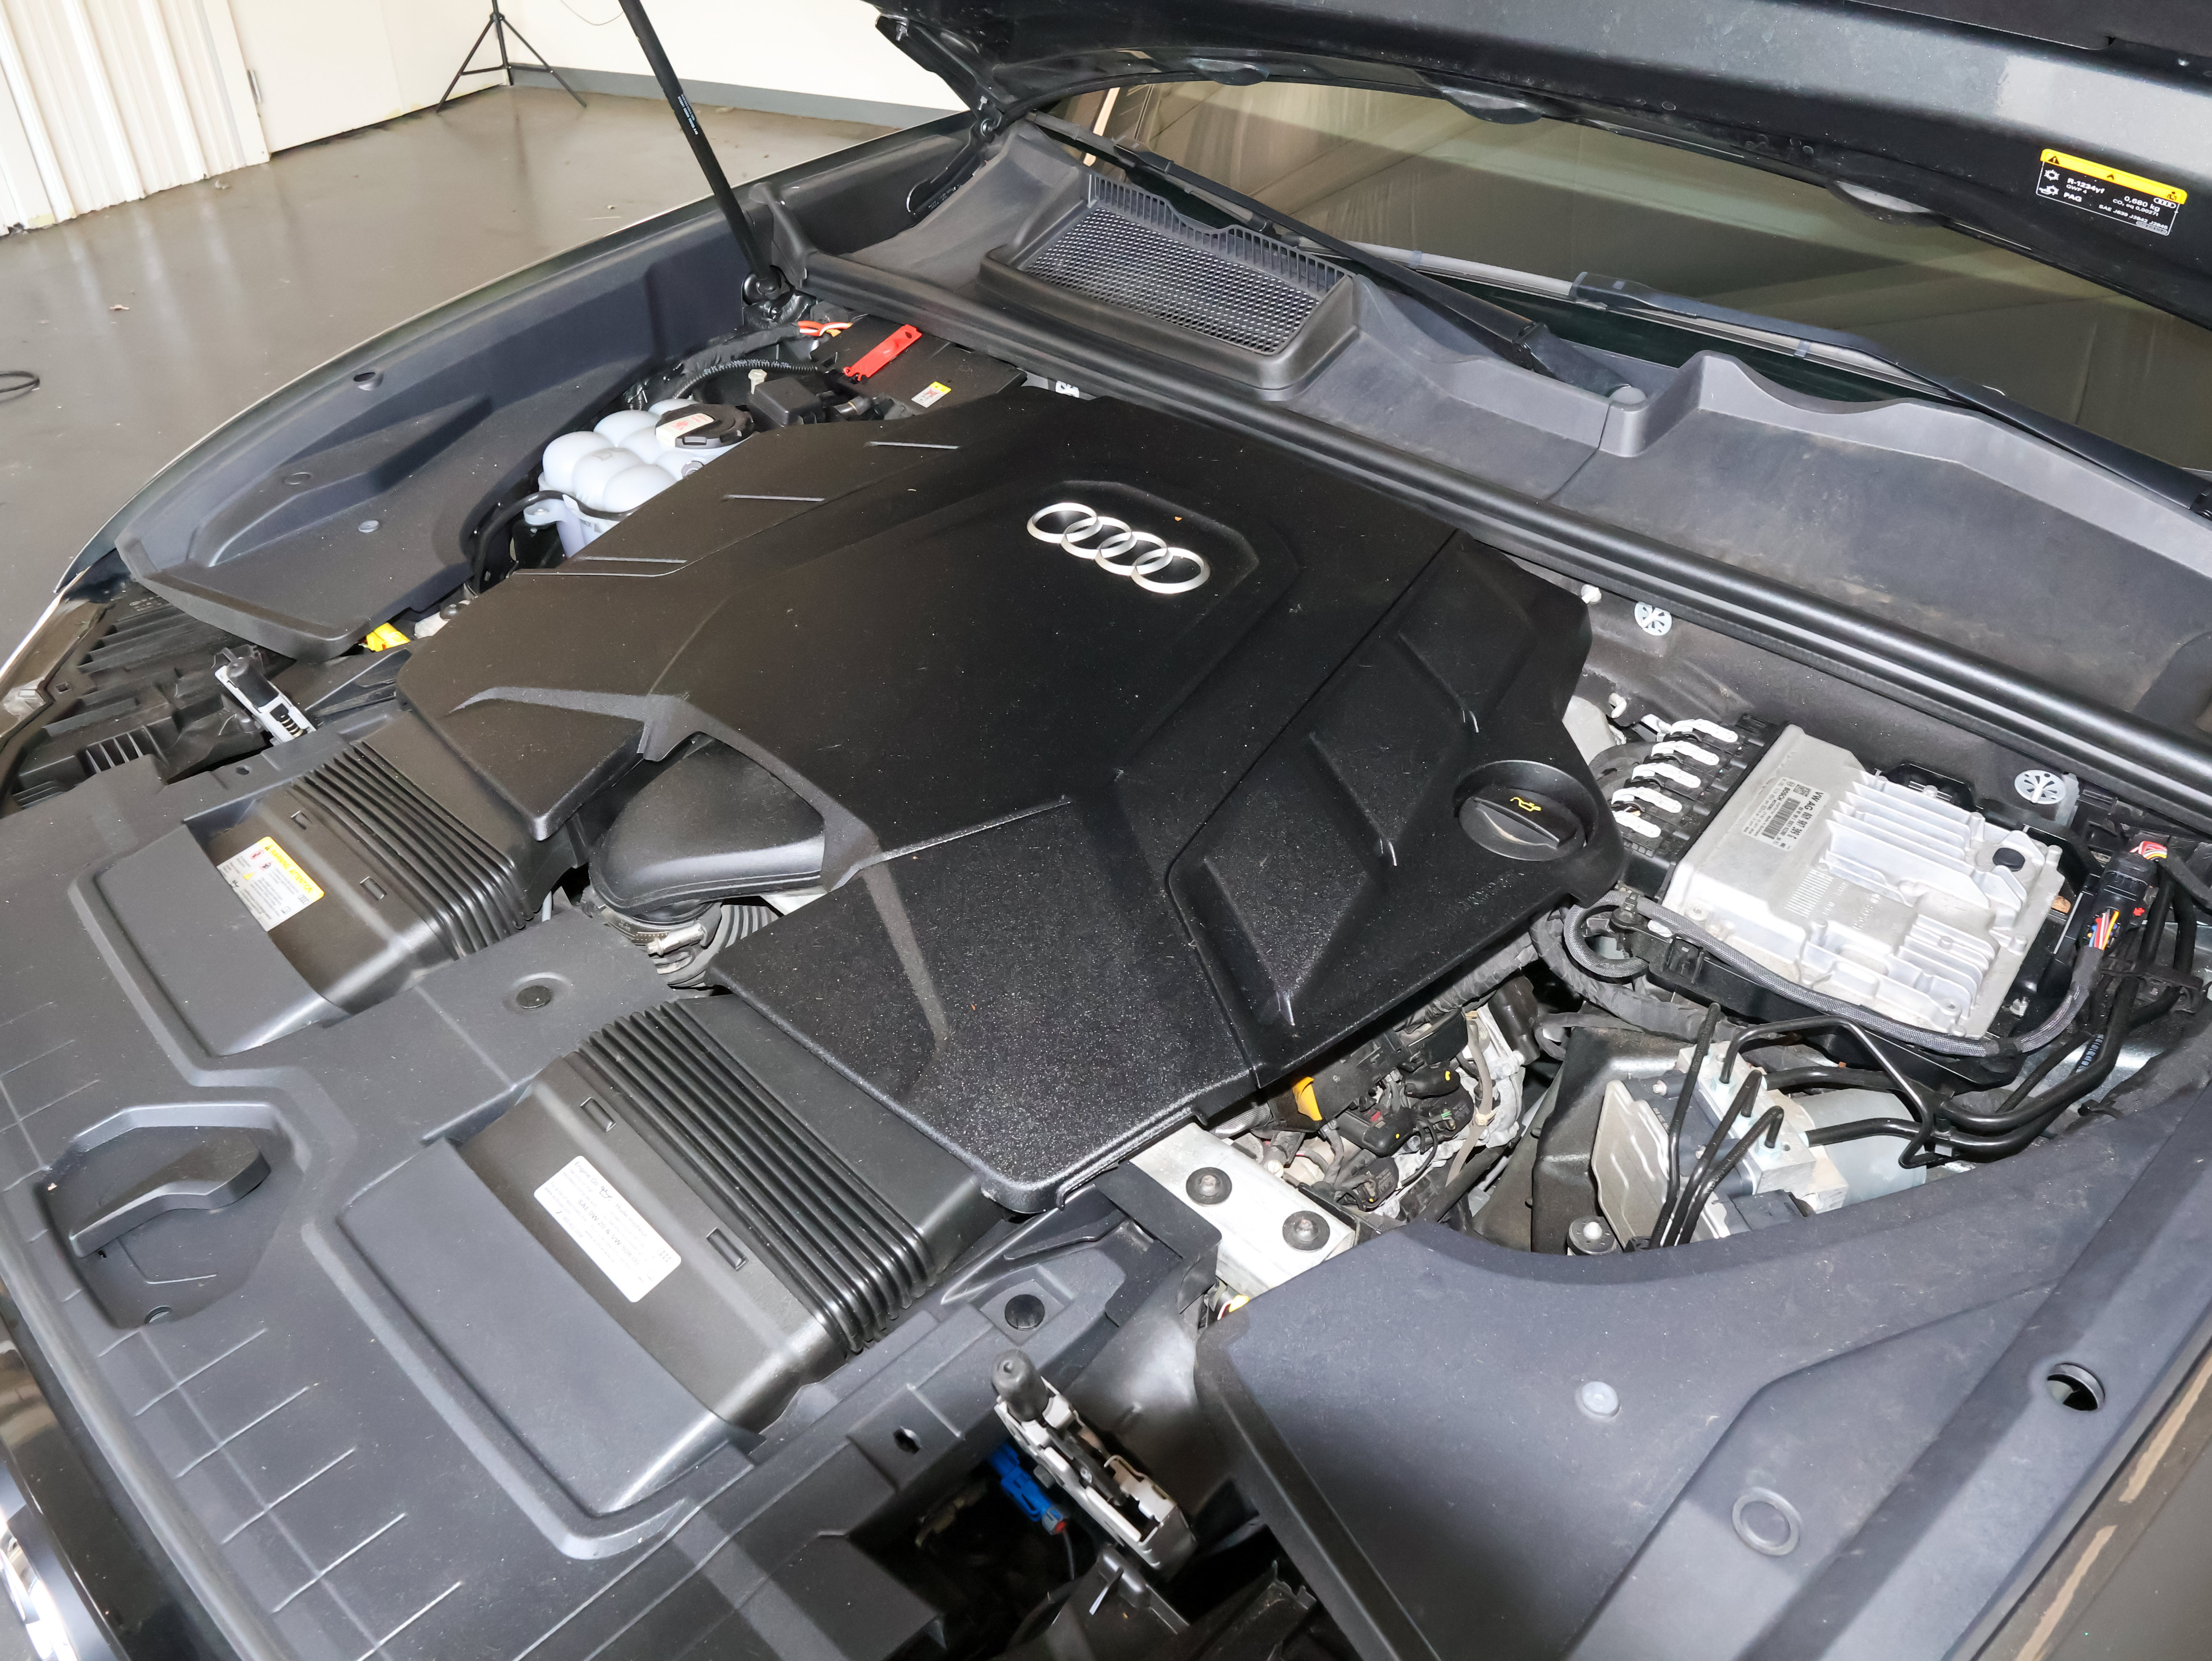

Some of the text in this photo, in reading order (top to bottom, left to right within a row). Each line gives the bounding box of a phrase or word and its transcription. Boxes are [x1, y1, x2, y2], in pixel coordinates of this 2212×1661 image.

[2068, 178, 2104, 194] R-1234yf
[2064, 192, 2082, 202] PAG
[2124, 196, 2147, 207] 0,680
[1777, 787, 1790, 800] BOSCH
[1811, 791, 1823, 801] VW
[1804, 801, 1816, 811] AG
[270, 849, 291, 869] WARNING
[289, 869, 314, 893] ATTENTION
[573, 1161, 599, 1186] Engine Oil
[544, 1187, 571, 1214] wwwaudiusacom
[615, 1203, 629, 1217] Huile
[628, 1218, 648, 1237] moteur
[577, 1200, 589, 1210] SAE
[611, 1234, 622, 1246] VW
[621, 1245, 632, 1257] 508
[631, 1256, 640, 1265] 00
